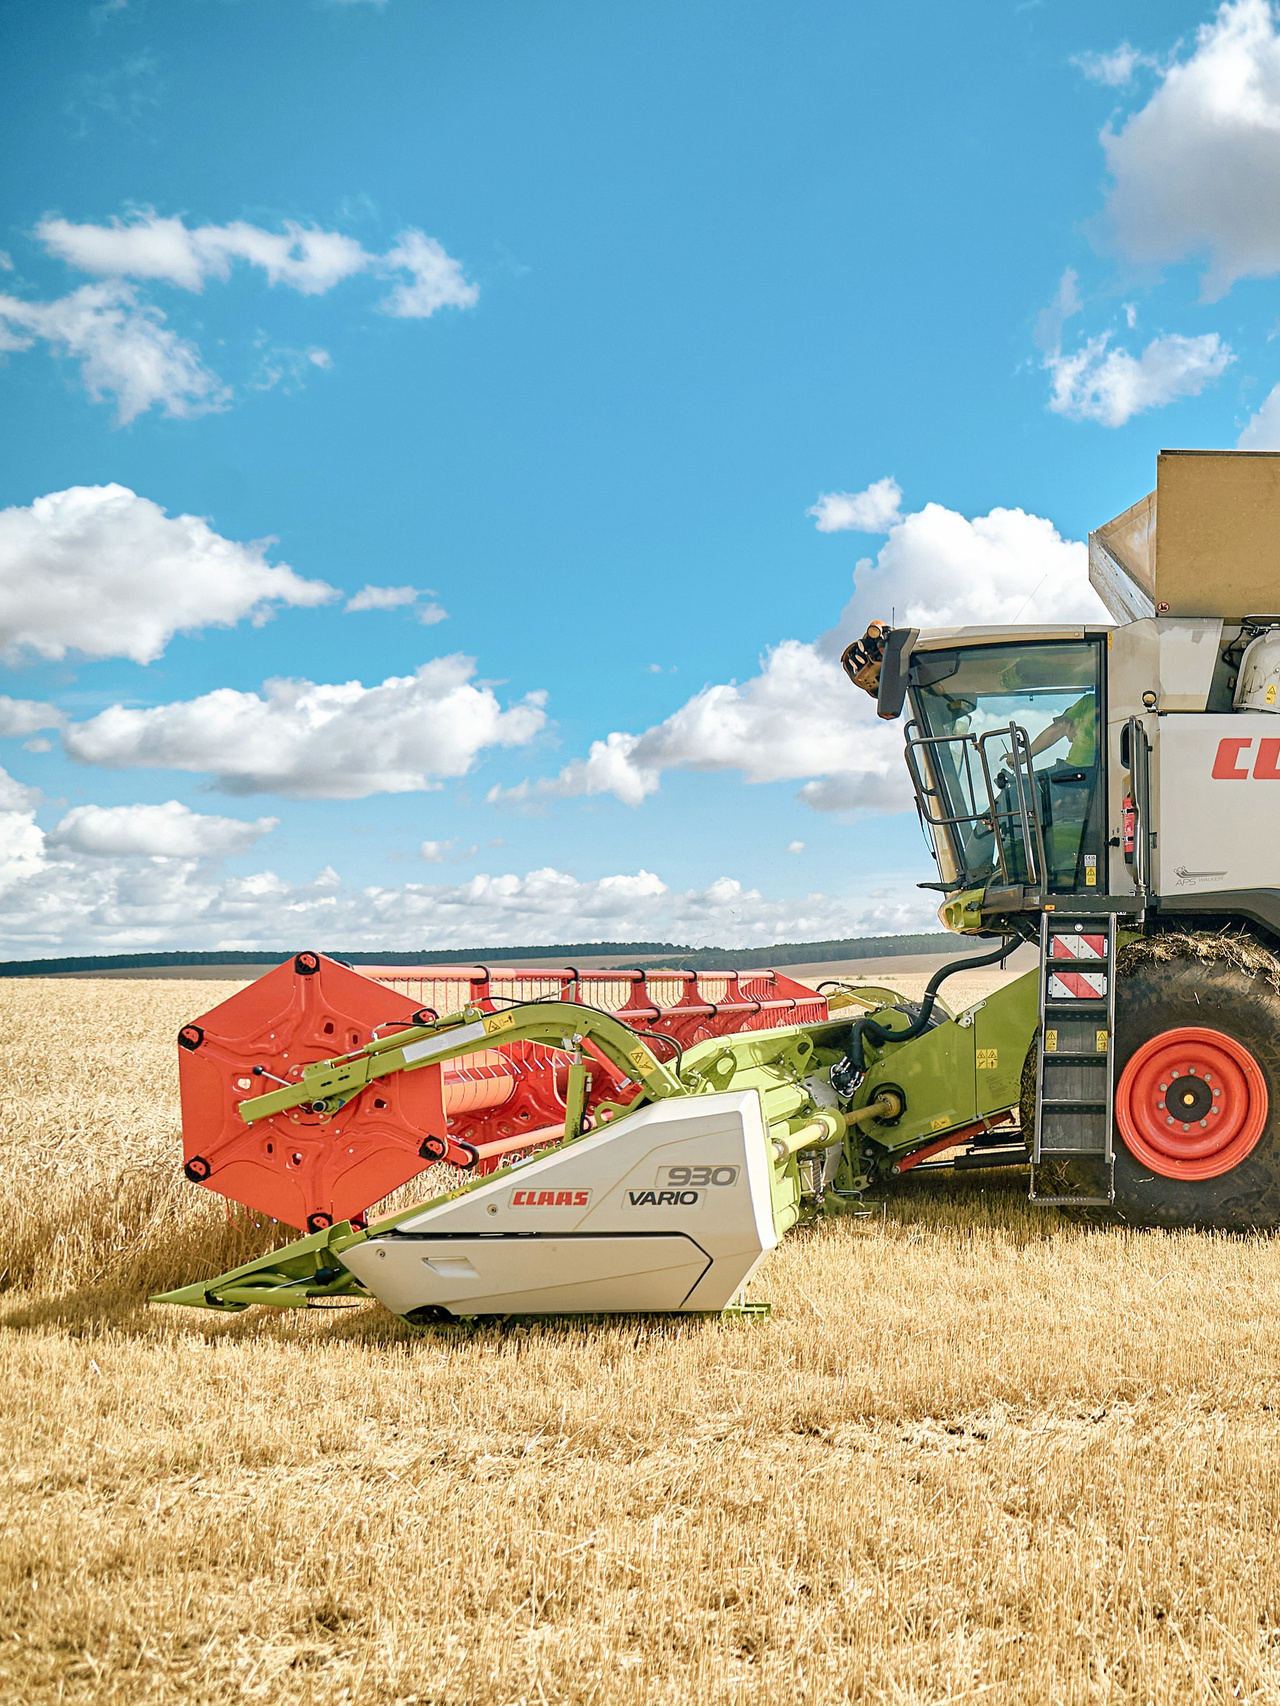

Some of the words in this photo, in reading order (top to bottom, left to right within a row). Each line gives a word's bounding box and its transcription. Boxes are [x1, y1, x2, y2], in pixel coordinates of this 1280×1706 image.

[1174, 878, 1197, 887] APS
[667, 1167, 737, 1186] 930
[512, 1191, 589, 1206] CLAAS
[628, 1191, 699, 1206] VARIO
